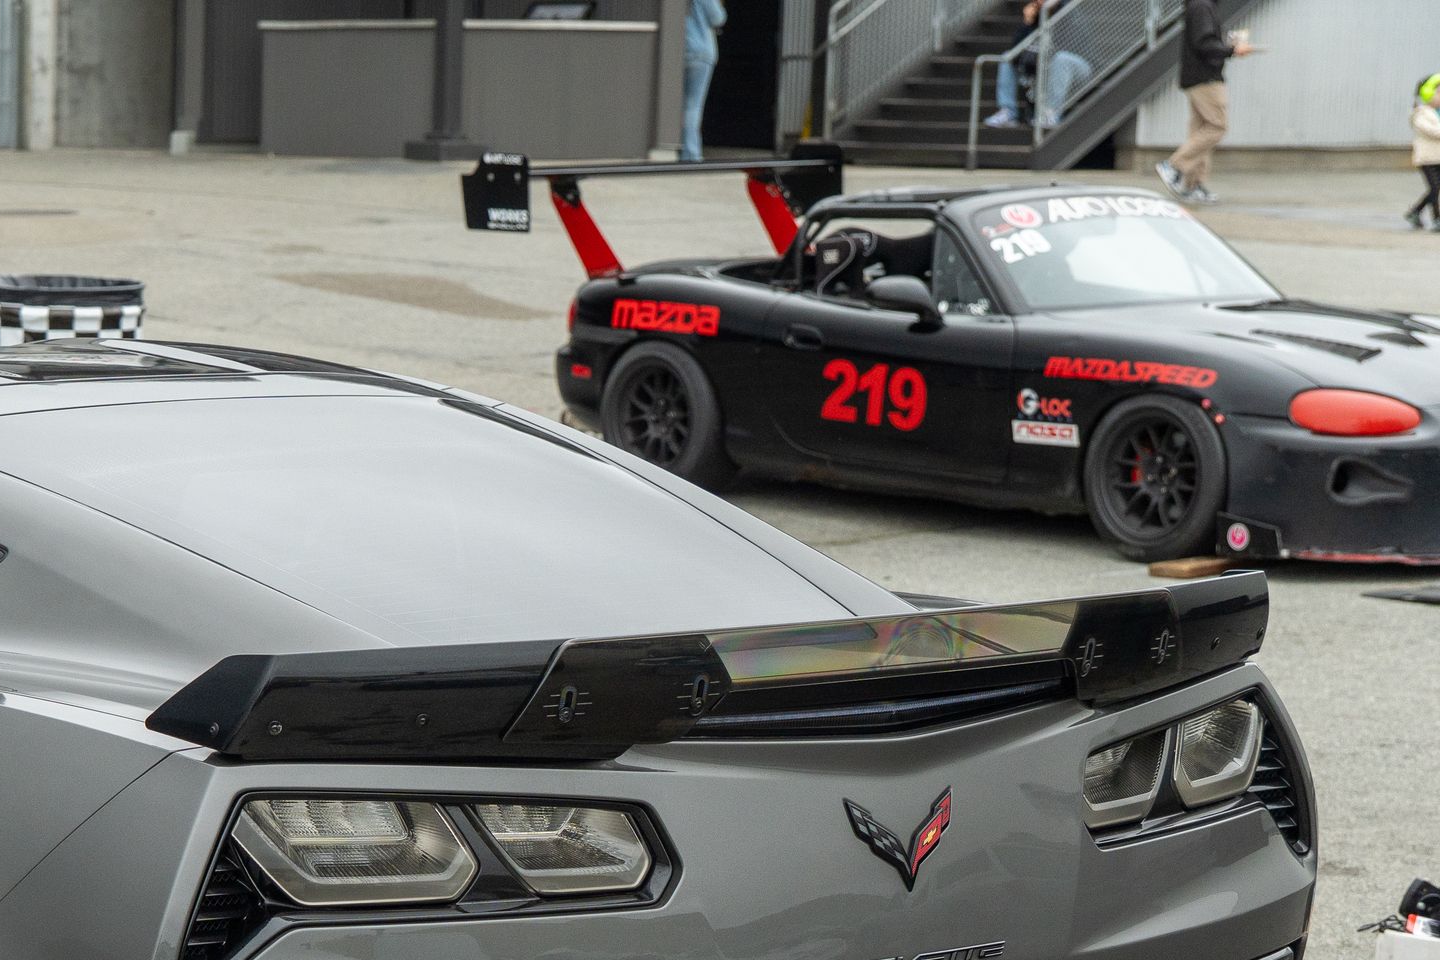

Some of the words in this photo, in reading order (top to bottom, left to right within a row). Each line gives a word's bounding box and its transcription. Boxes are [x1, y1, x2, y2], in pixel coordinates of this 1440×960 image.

[990, 229, 1051, 263] 219
[1044, 356, 1218, 388] MAZDASPEED
[821, 358, 927, 431] 219
